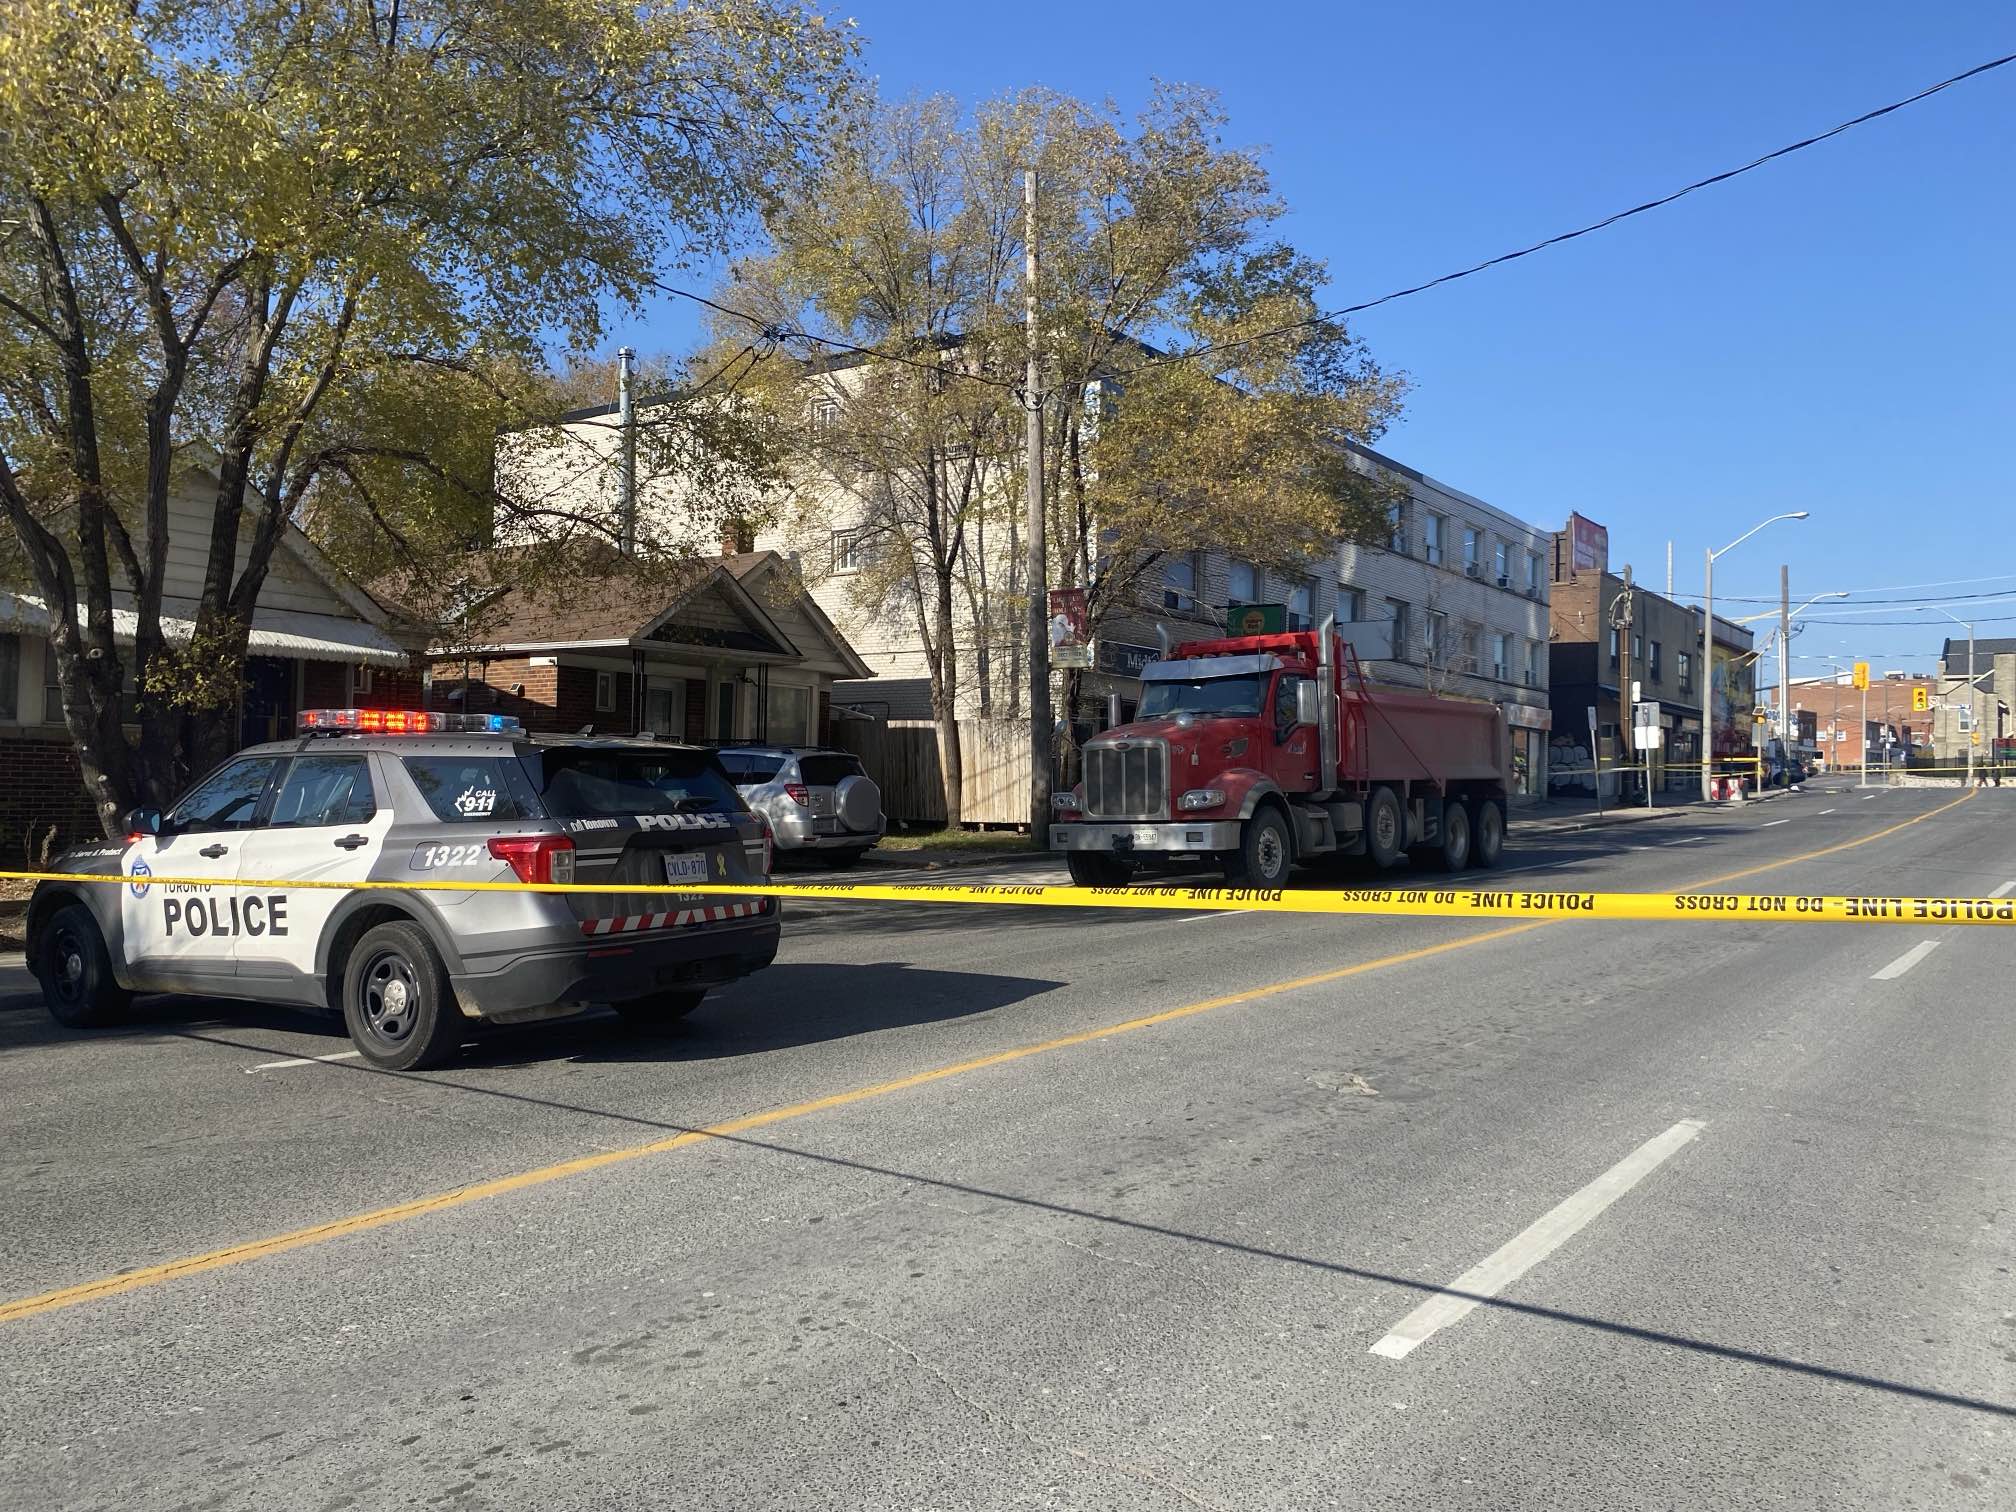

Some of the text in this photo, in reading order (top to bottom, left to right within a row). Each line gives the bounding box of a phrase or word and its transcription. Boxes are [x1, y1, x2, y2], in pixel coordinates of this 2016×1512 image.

[475, 789, 497, 797] CALL
[463, 796, 495, 812] 9-1-1
[635, 812, 731, 832] POLICE
[424, 844, 482, 867] 1322
[1226, 889, 1283, 902] POLICE
[1342, 889, 1393, 902] CROSS
[1397, 890, 1427, 904] NOT
[1433, 891, 1456, 904] DO
[1521, 894, 1594, 911] POLICE
[1674, 895, 1738, 911] CROSS
[1746, 895, 1786, 911] NOT
[1795, 896, 1824, 913] DO
[1913, 899, 2015, 920] POLICE
[163, 895, 289, 937] POLICE
